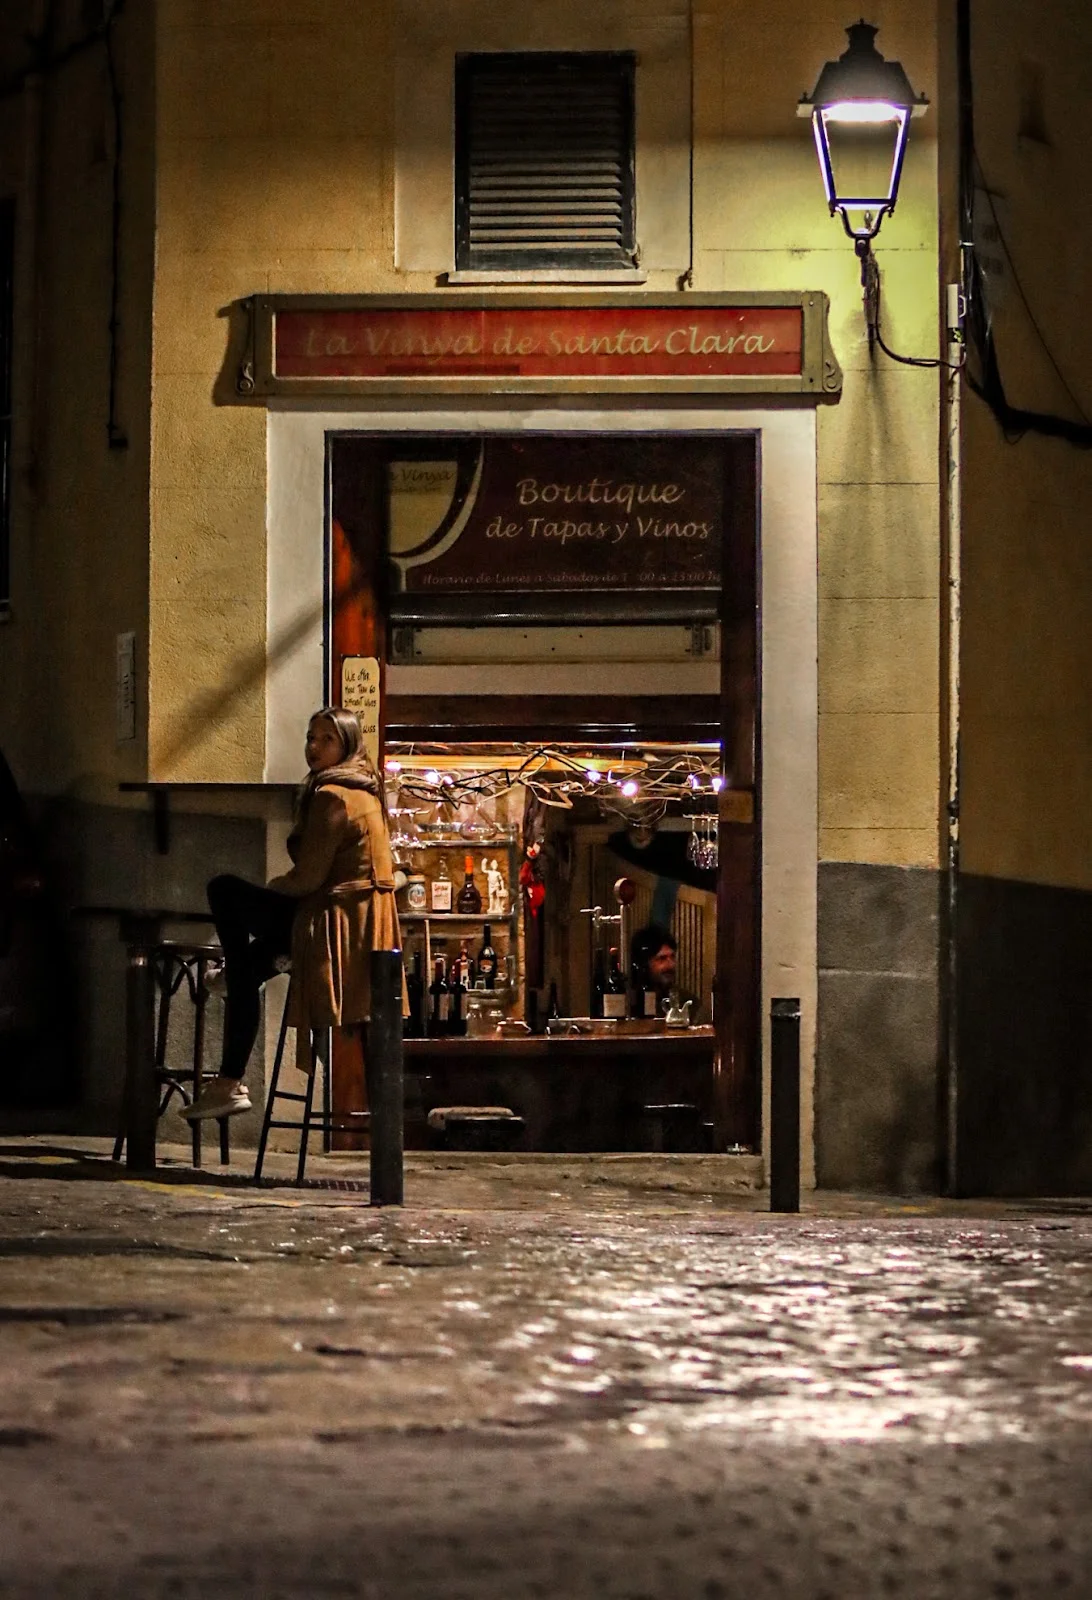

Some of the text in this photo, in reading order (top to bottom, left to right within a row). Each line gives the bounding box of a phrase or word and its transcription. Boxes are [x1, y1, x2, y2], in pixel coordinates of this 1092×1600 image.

[304, 326, 777, 365] La Vinya de Santa Clara
[515, 477, 687, 514] Boutique
[485, 515, 714, 545] de Tapas y Vinos
